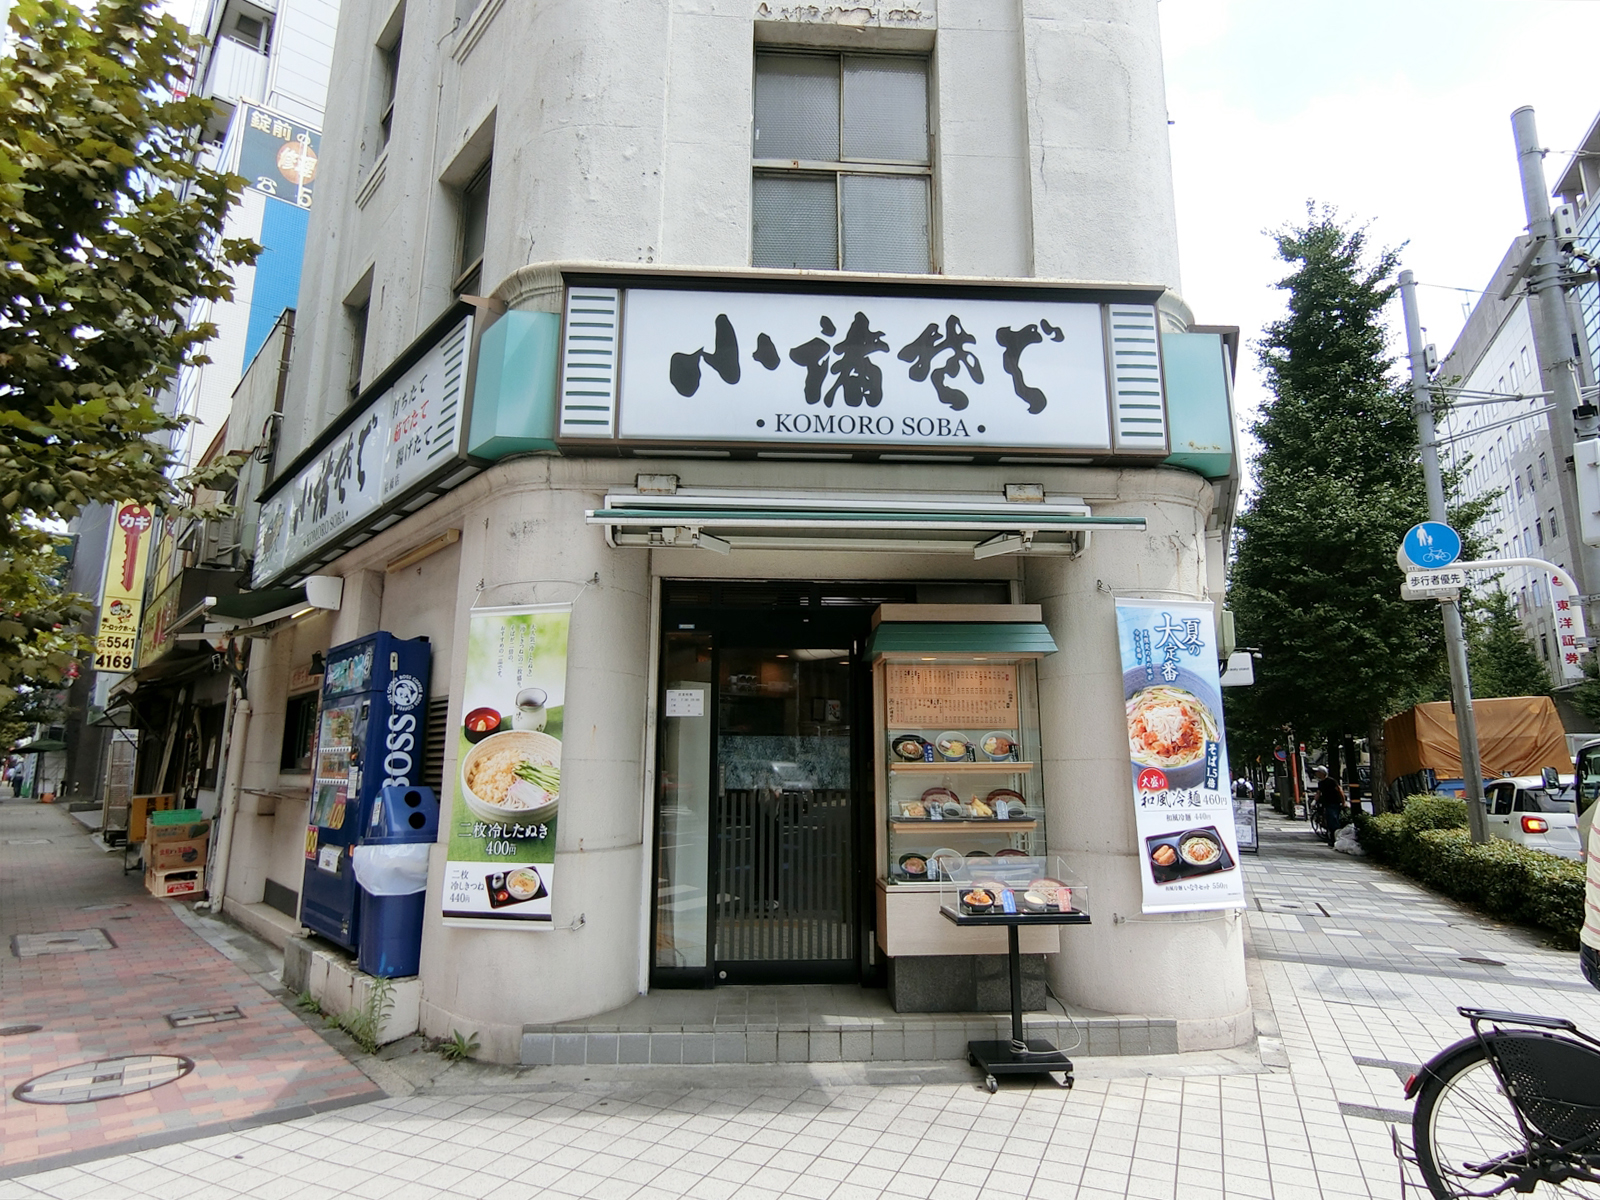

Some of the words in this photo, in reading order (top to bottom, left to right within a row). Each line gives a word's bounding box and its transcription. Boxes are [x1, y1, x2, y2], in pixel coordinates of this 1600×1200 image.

[774, 412, 895, 436] KOMORO
[901, 416, 971, 437] SOBA
[120, 514, 150, 531] カギ
[306, 519, 330, 548] KOMORO
[329, 509, 346, 532] SOBA
[1410, 574, 1462, 587] 歩行者優先
[101, 623, 136, 632] ツーロックホーム
[1555, 600, 1580, 665] 東洋証券
[106, 636, 135, 649] 5541
[1182, 618, 1206, 656] 夏の
[1154, 612, 1187, 682] 大定番
[95, 654, 132, 669] 4169
[1141, 775, 1165, 788] 大盛り
[1140, 789, 1202, 809] 和風冷麺
[1203, 794, 1228, 806] 460円
[1166, 813, 1192, 822] 和風冷麺
[458, 821, 549, 840] 二枚冷したぬき
[485, 840, 517, 856] 400円
[452, 869, 469, 880] 二枚
[450, 880, 485, 891] 冷しきつね
[449, 892, 471, 903] 440円
